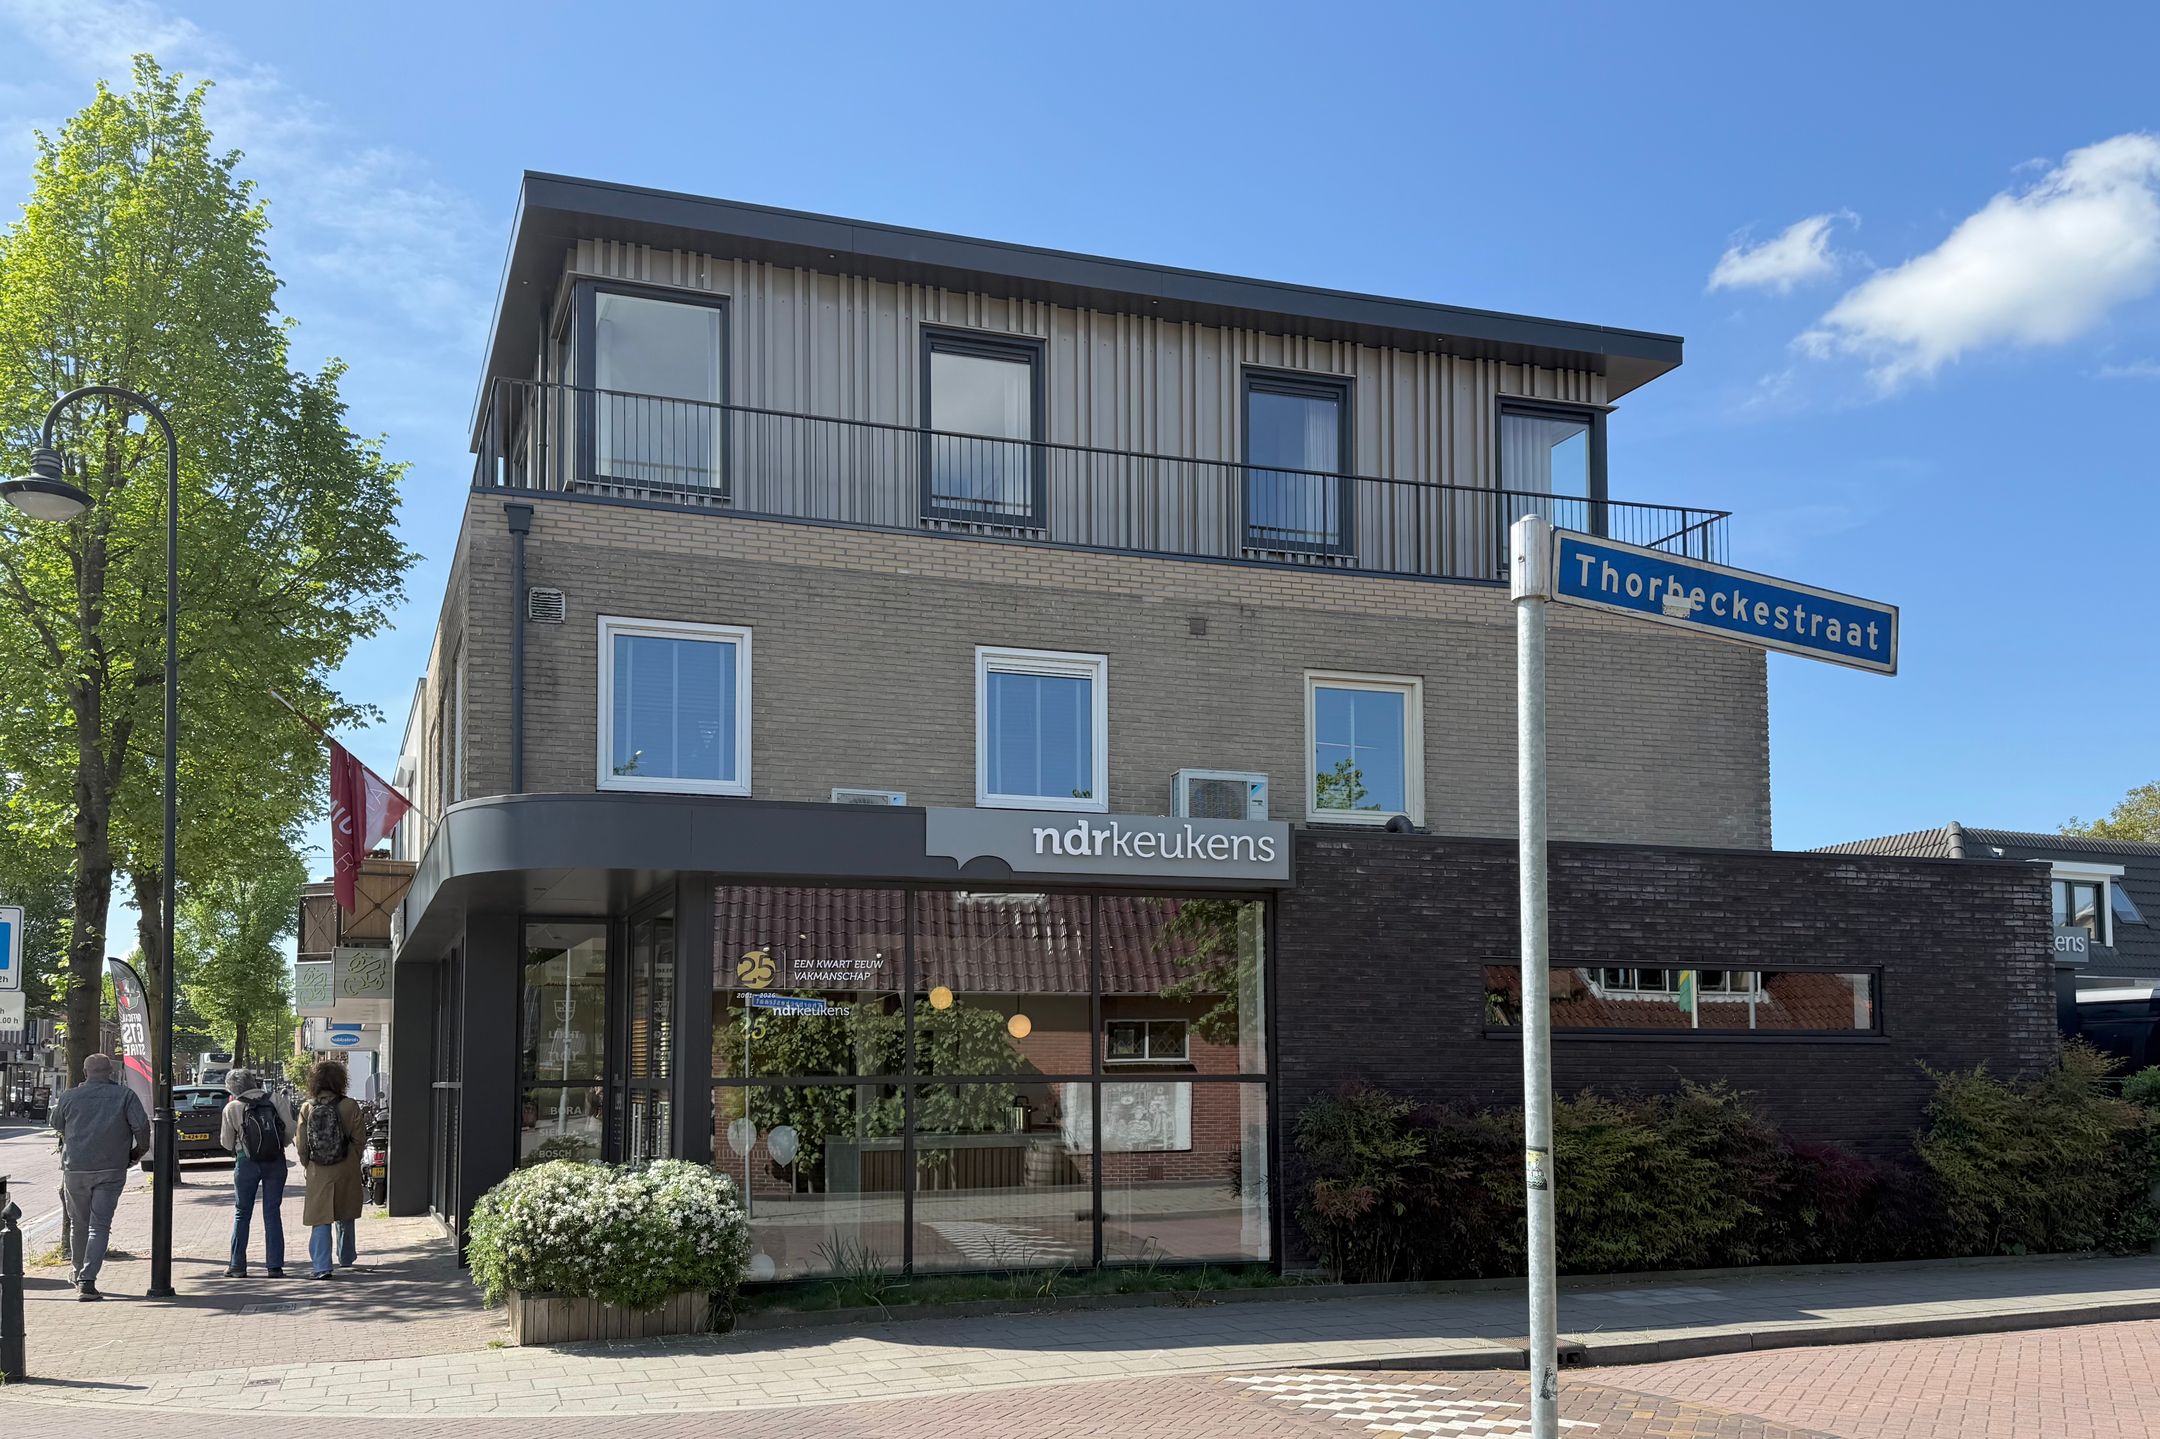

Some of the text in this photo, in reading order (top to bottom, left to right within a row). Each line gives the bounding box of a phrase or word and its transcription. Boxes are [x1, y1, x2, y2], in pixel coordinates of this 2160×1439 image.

[1575, 553, 1880, 651] Thorbeckestraat
[1032, 820, 1276, 863] ndrkeukens
[2053, 935, 2085, 952] ens
[738, 955, 776, 984] 25
[794, 960, 884, 969] EEN KWART EEUW
[794, 972, 871, 981] VAKMANSCHAP
[773, 1004, 850, 1016] ndrkeukens
[550, 1106, 582, 1115] BORA
[538, 1149, 572, 1159] BOSCH
